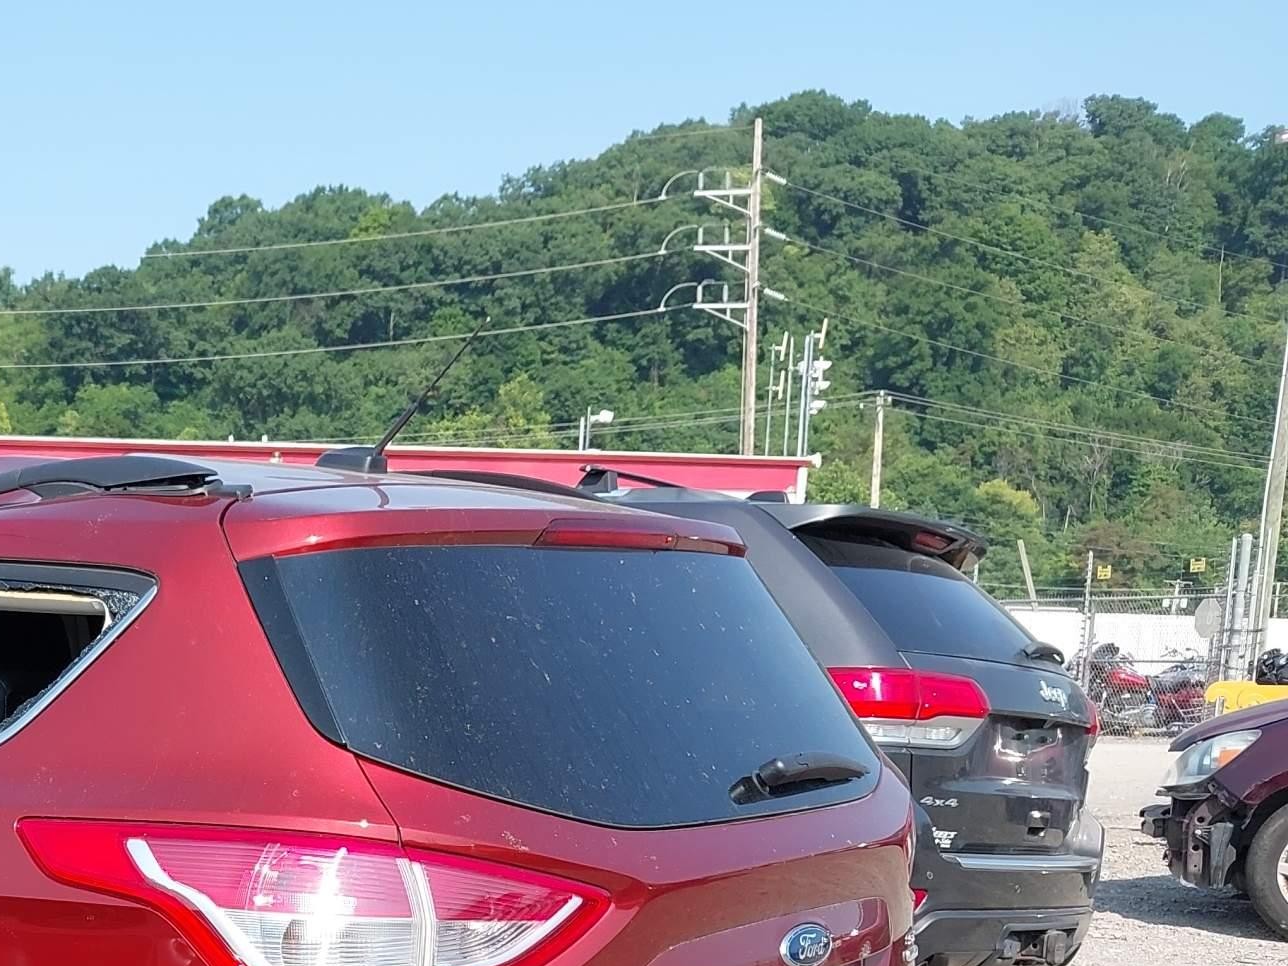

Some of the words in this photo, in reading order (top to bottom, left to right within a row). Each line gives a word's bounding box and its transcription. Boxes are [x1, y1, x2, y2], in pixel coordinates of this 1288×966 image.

[1039, 679, 1068, 711] Jeep
[919, 796, 959, 808] 4x4
[798, 933, 827, 960] Ford
